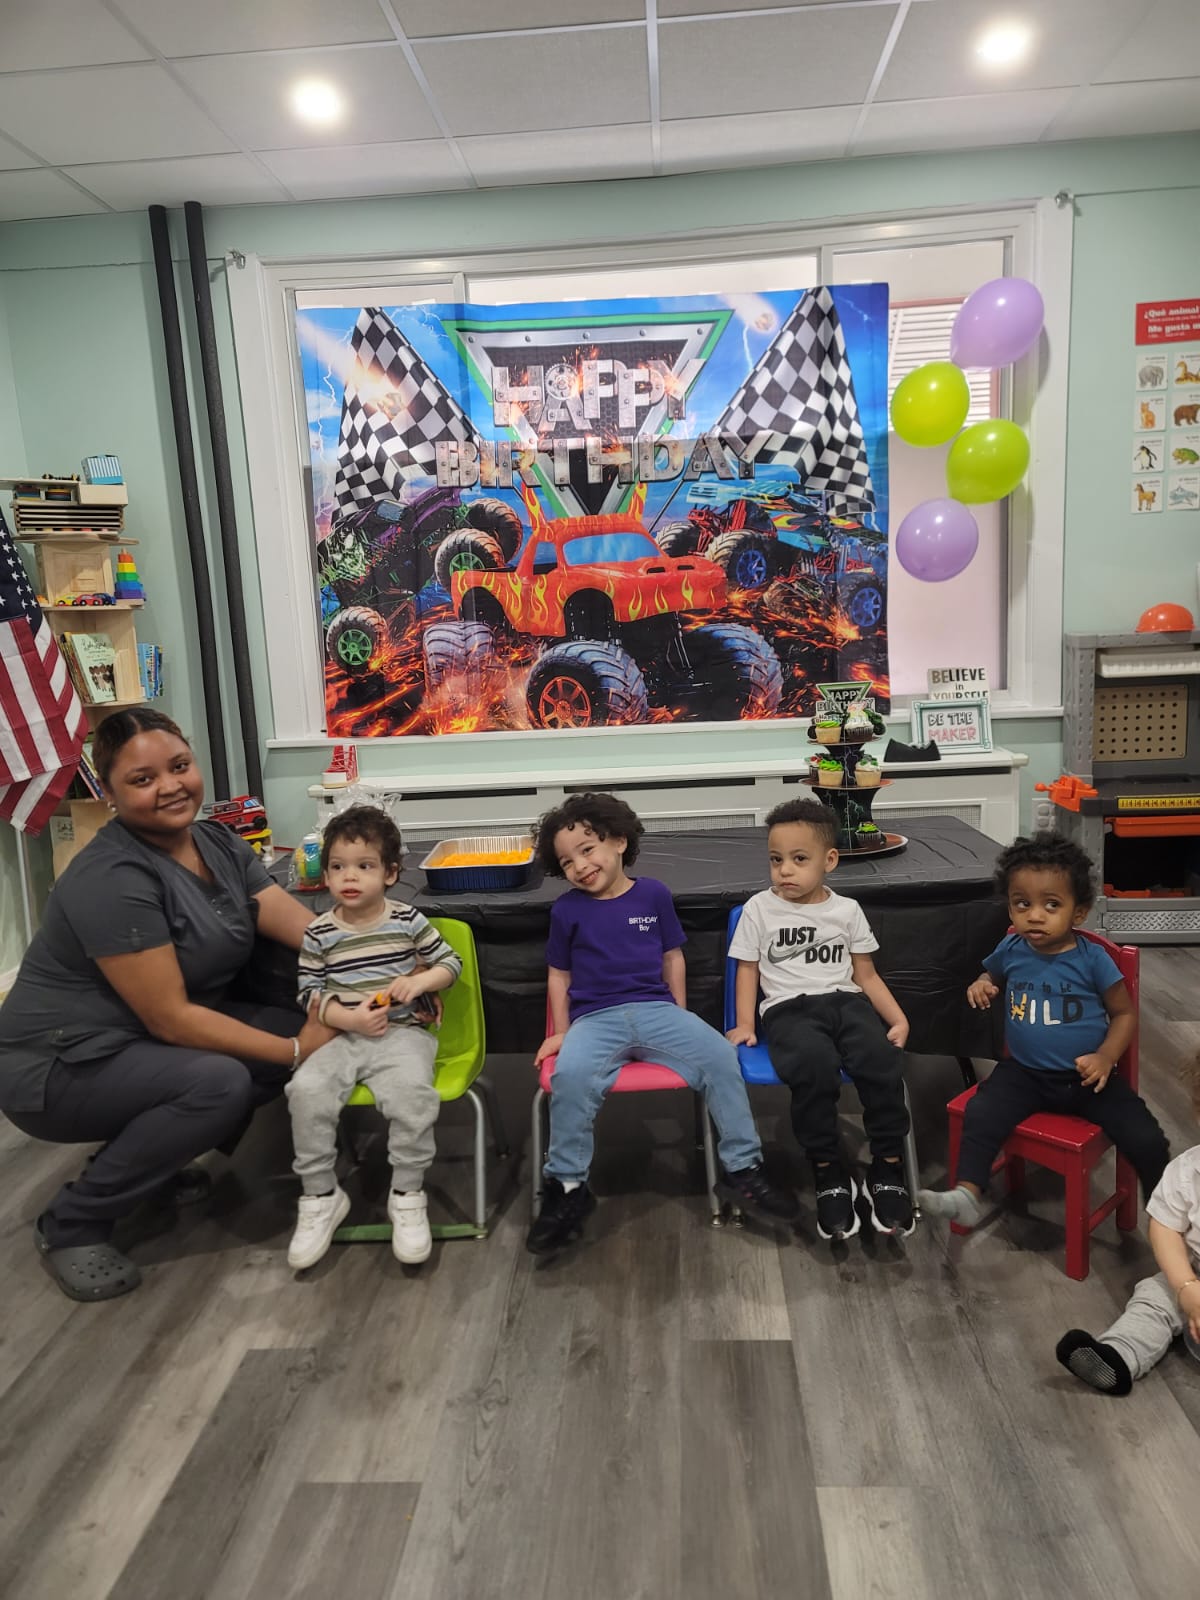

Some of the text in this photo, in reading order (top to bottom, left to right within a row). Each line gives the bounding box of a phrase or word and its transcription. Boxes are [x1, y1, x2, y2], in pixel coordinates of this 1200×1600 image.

[1168, 305, 1200, 316] animal
[1147, 325, 1163, 333] Me
[1164, 323, 1191, 334] gusta
[492, 358, 706, 430] HAPPY
[435, 432, 774, 488] BIRTHDAY
[932, 667, 986, 684] BELIEVE
[955, 682, 964, 691] in
[828, 690, 863, 701] HAPPY
[947, 711, 973, 726] THE
[928, 727, 977, 742] MAKER
[628, 916, 657, 925] BIRTHDAY
[776, 926, 817, 948] JUST
[805, 944, 844, 964] DO IT
[1010, 990, 1083, 1026] WILD
